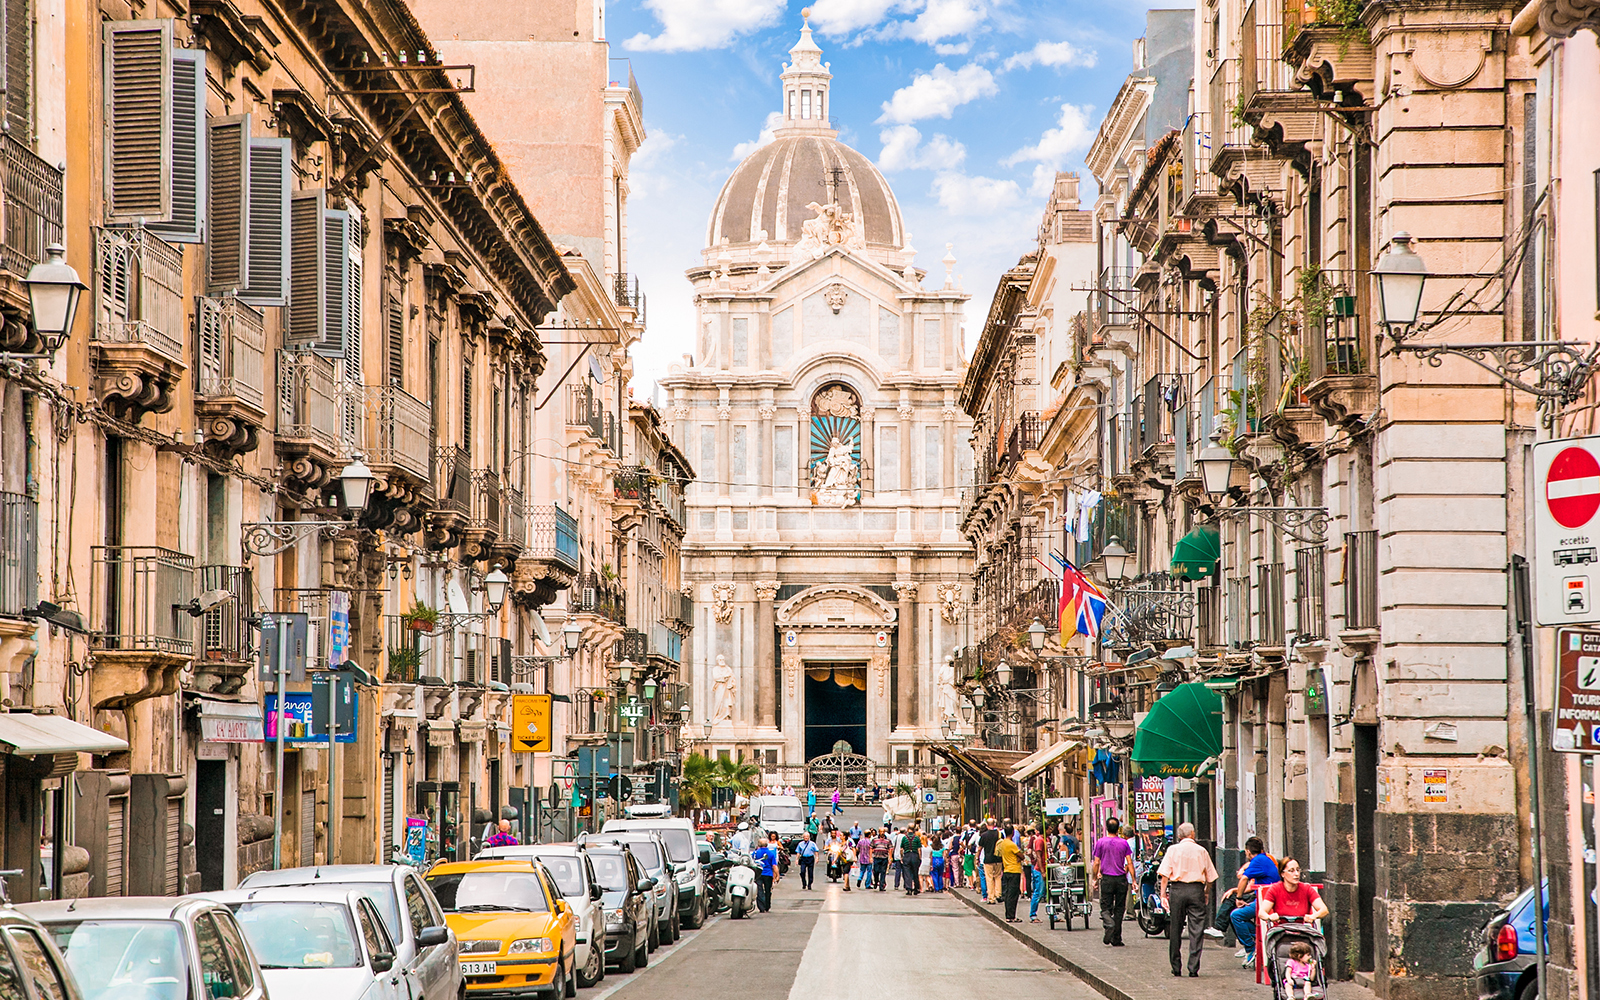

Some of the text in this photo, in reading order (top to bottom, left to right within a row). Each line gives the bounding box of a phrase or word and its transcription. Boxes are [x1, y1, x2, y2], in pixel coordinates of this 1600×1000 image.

[1560, 537, 1589, 545] eccetto
[1583, 634, 1600, 642] CITT
[1160, 764, 1190, 774] Piccolo
[1142, 782, 1164, 790] NOW
[1425, 786, 1431, 795] 4
[1135, 792, 1164, 800] ETNA
[1135, 801, 1164, 810] DAILY
[461, 963, 495, 973] 613 AH
